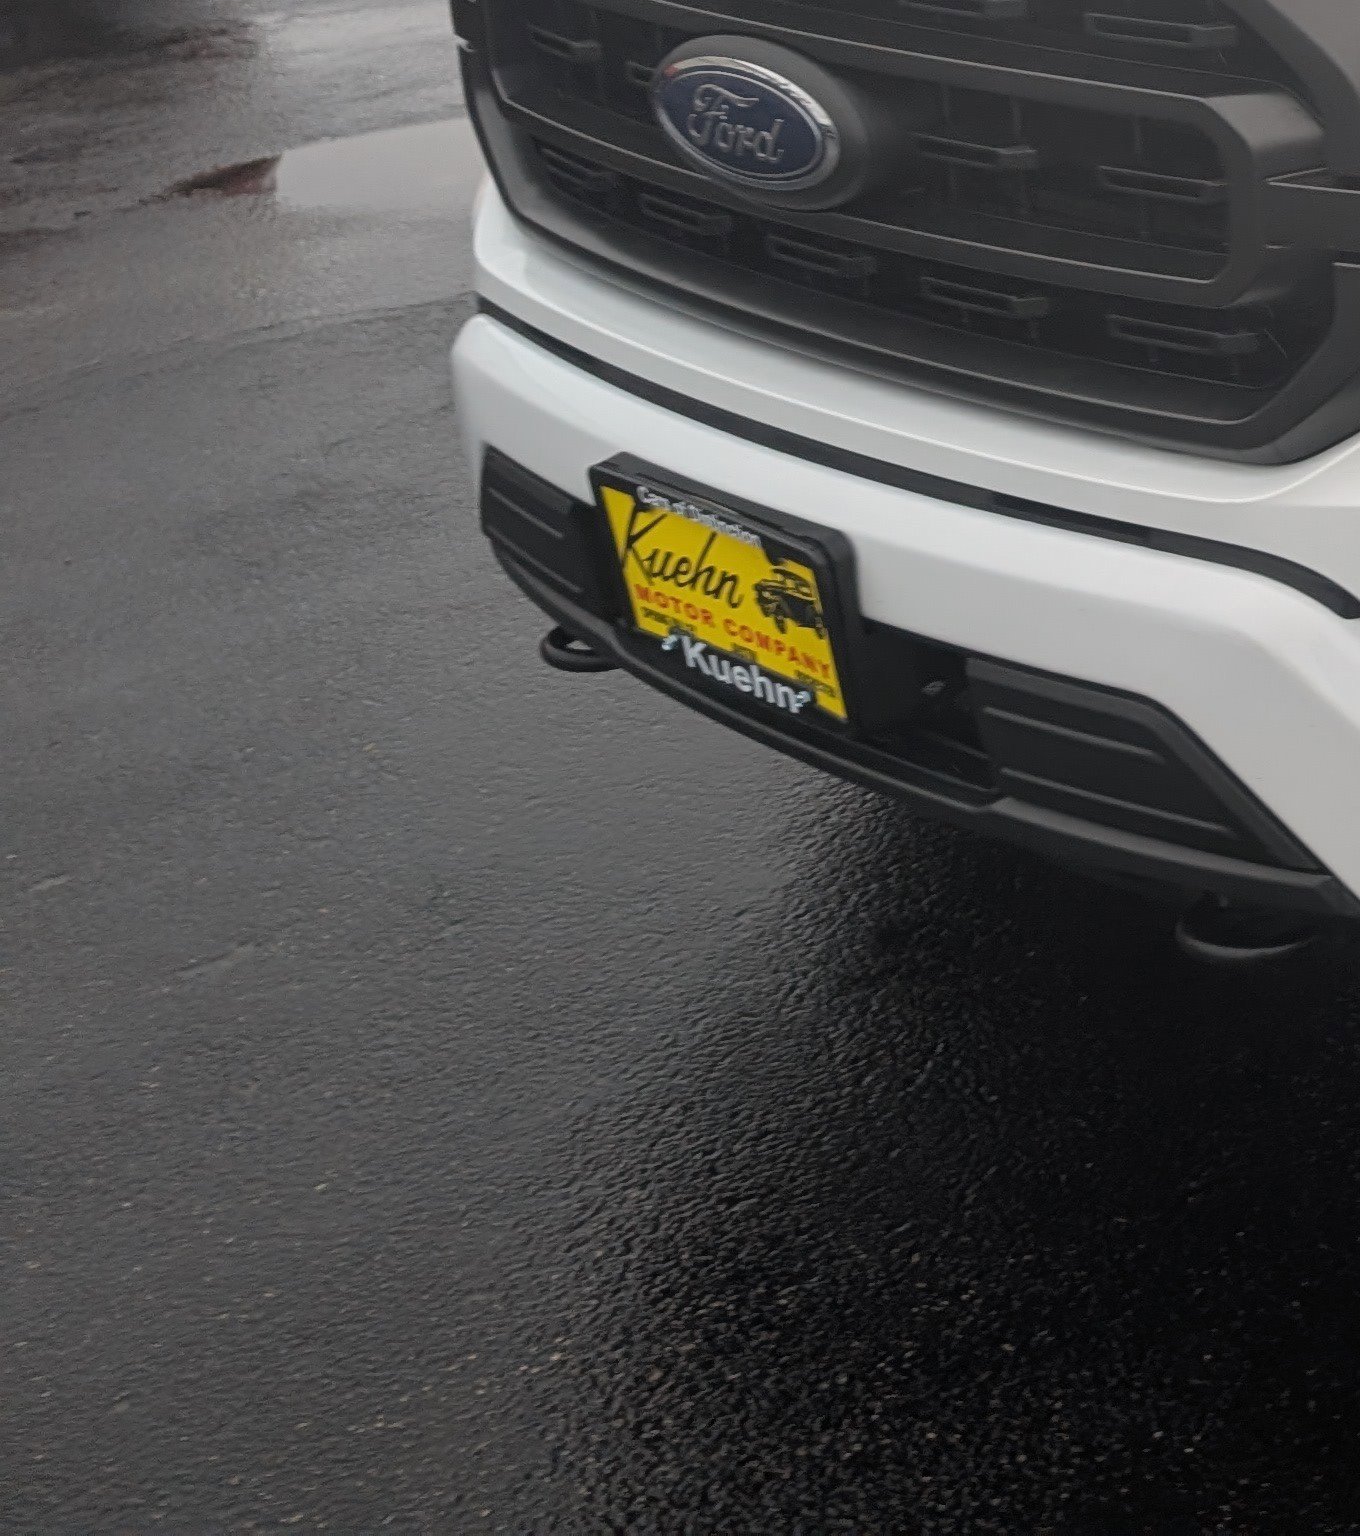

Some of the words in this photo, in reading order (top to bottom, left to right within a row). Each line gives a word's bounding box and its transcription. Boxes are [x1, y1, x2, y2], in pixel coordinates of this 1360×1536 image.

[688, 83, 786, 163] Ford
[619, 500, 744, 609] Kuehn
[634, 582, 717, 629] MOTOR
[721, 617, 833, 680] COMPANY
[679, 633, 800, 714] Kuehn
